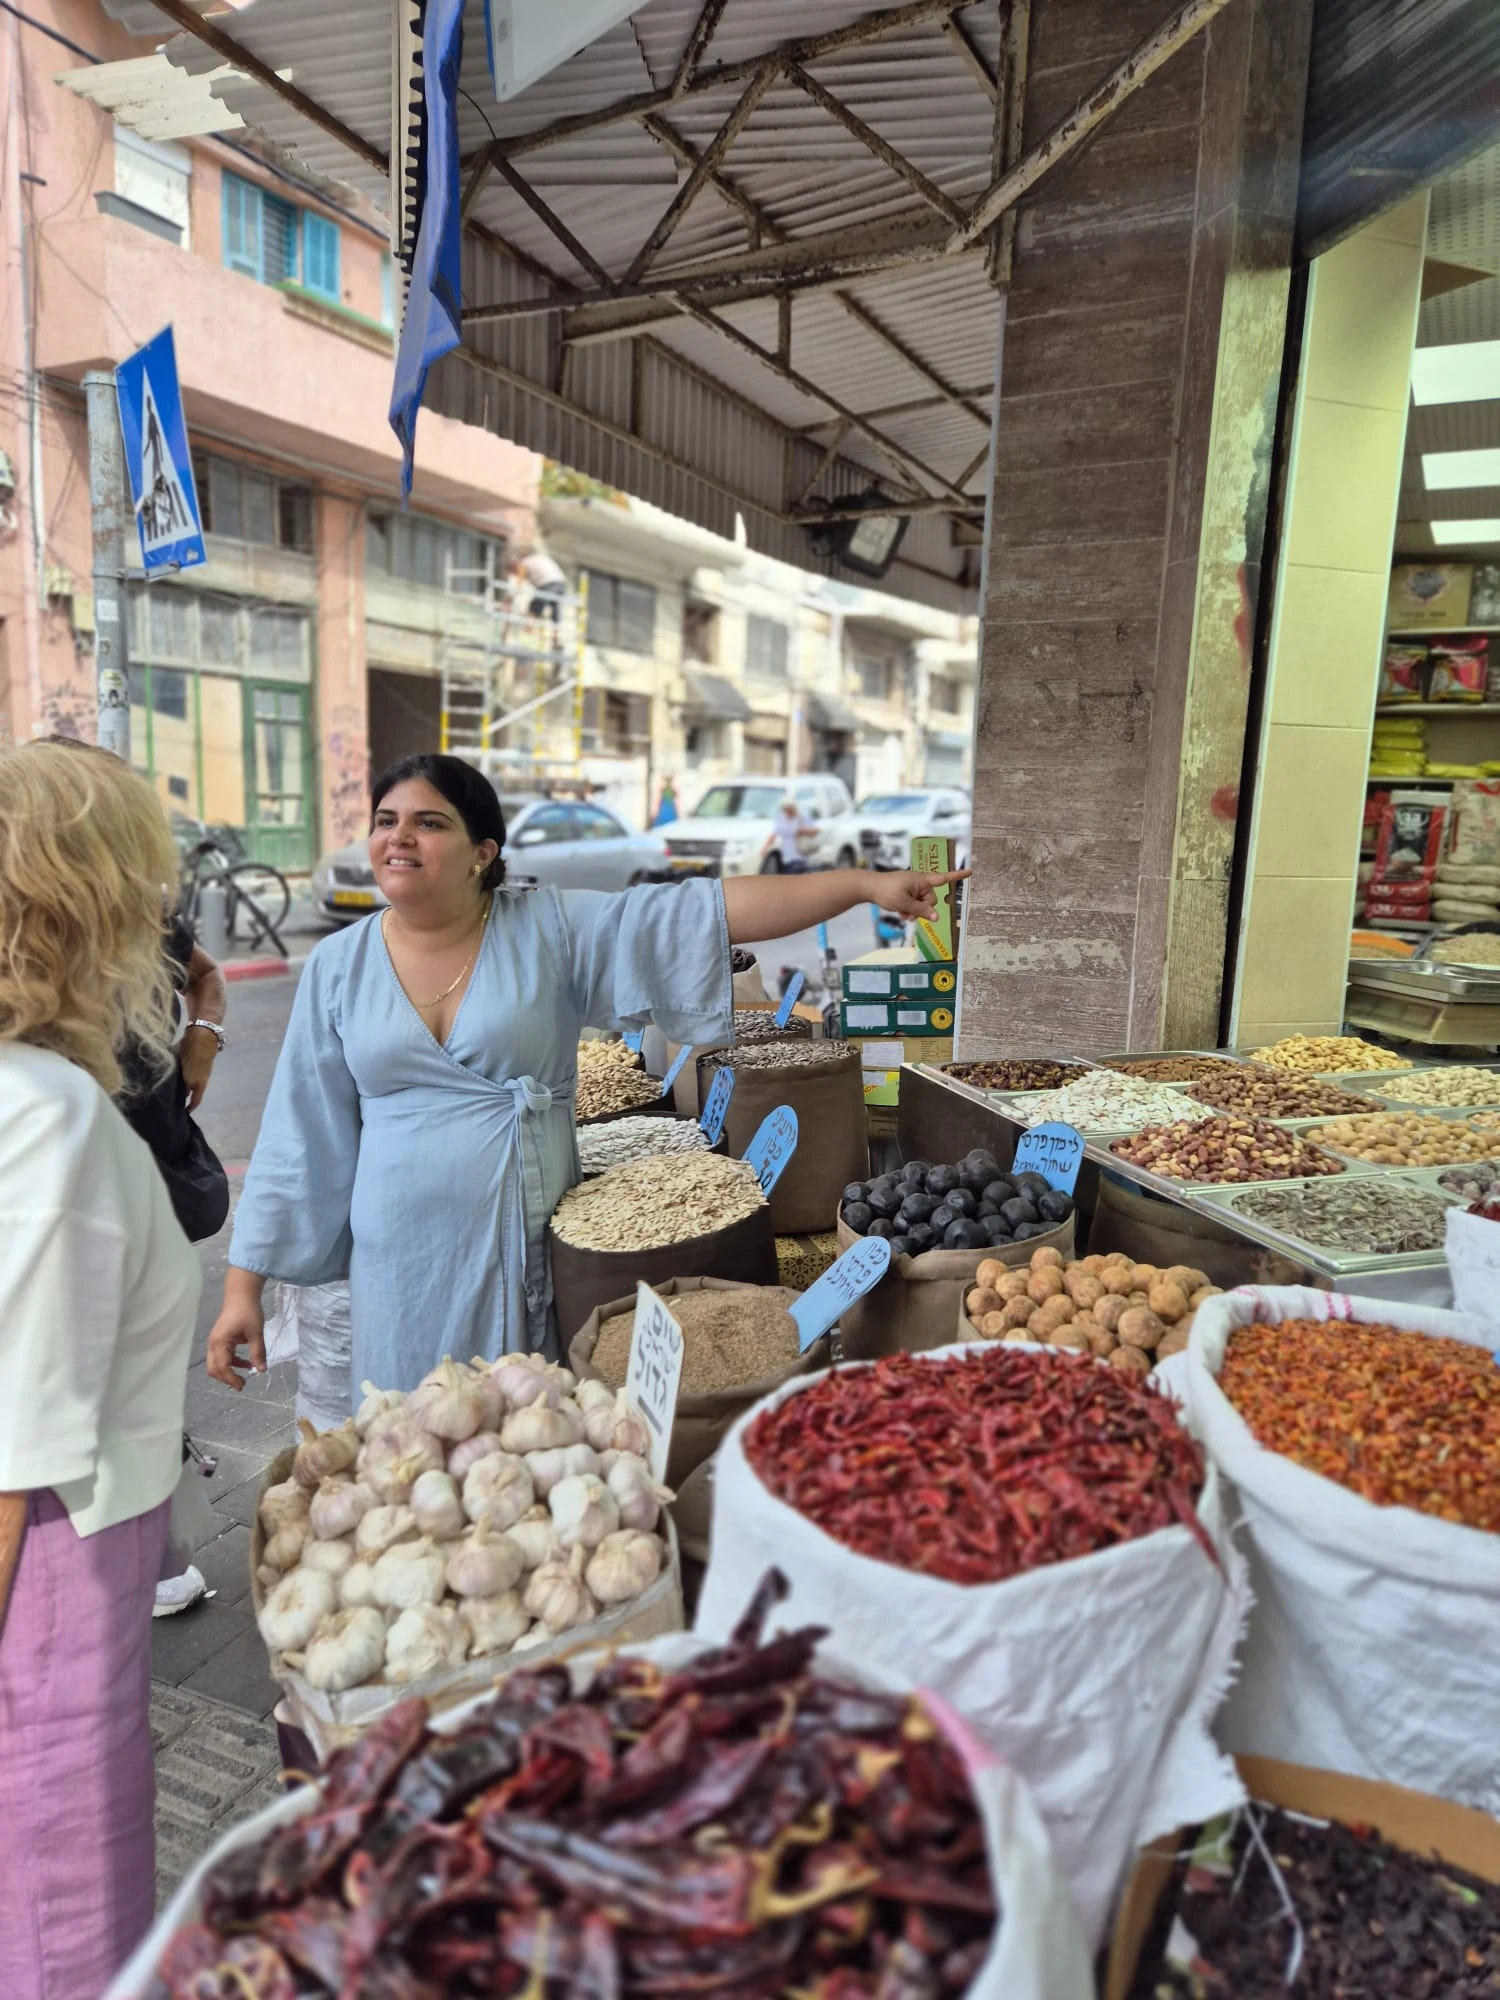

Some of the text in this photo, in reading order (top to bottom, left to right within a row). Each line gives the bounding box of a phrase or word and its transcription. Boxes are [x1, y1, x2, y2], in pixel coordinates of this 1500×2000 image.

[929, 843, 940, 874] ATES
[1020, 1133, 1079, 1156] לימון פרסי
[863, 1241, 887, 1265] כמון
[848, 1255, 872, 1284] פרסי
[653, 1303, 680, 1353] שום
[634, 1333, 667, 1416] גדול
